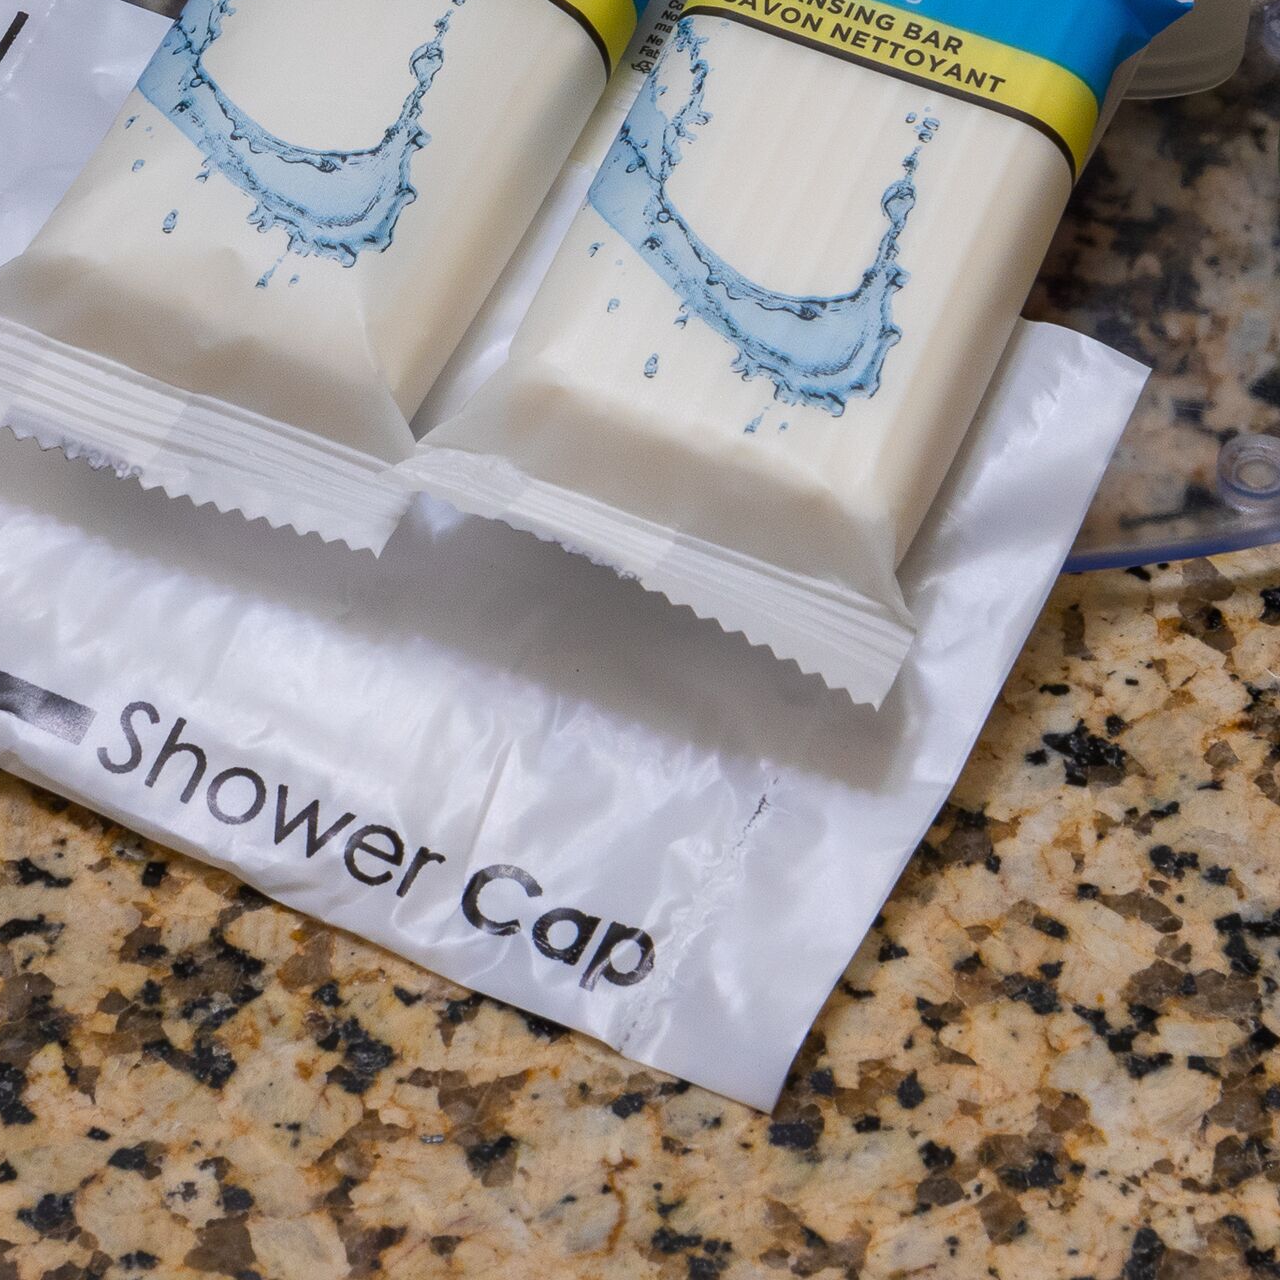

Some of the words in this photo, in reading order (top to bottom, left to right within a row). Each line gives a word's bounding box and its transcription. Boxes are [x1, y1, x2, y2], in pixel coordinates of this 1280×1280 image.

[830, 22, 1007, 94] NETTOYANT
[903, 21, 964, 55] BAR
[97, 701, 446, 900] Shower
[461, 863, 656, 992] Cap
